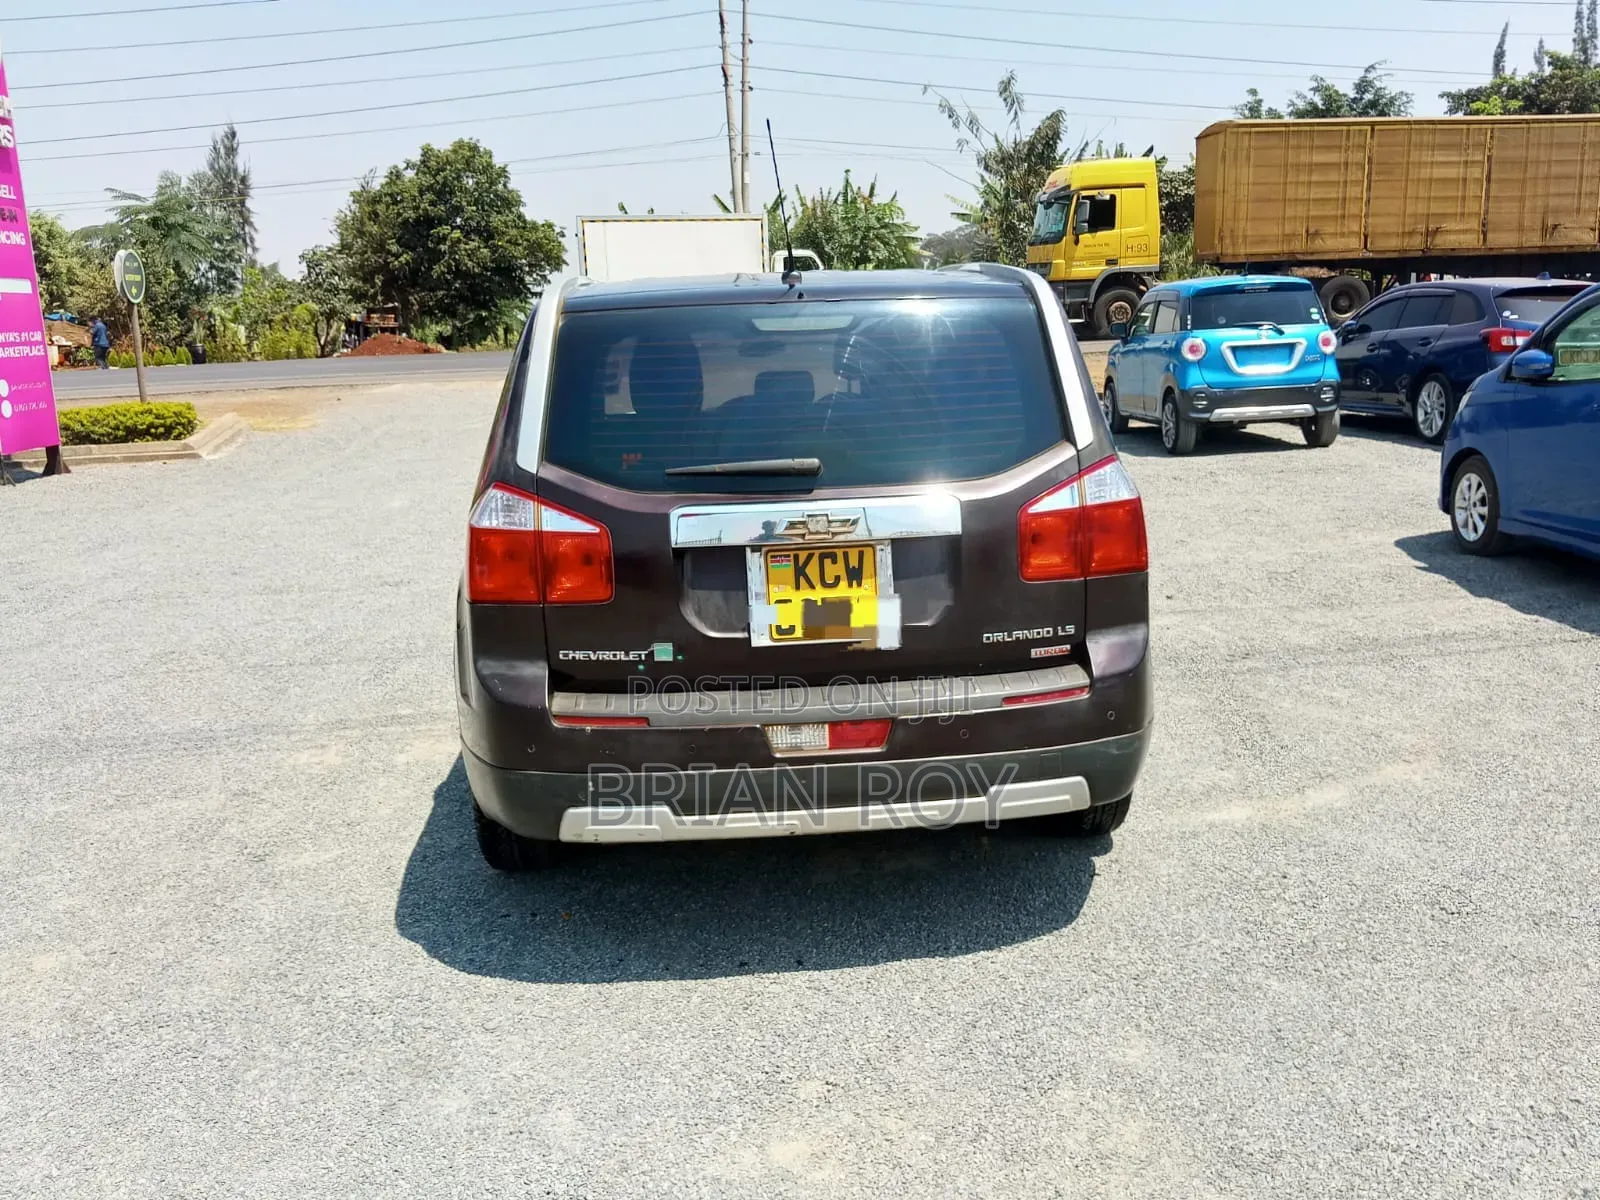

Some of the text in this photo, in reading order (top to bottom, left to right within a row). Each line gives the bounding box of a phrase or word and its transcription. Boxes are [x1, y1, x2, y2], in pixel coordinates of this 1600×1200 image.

[1126, 243, 1149, 253] H:93
[792, 550, 865, 591] KCW
[982, 624, 1076, 644] ORLANDO LS
[558, 650, 649, 661] CHEVROLET
[1033, 645, 1071, 657] TURBO
